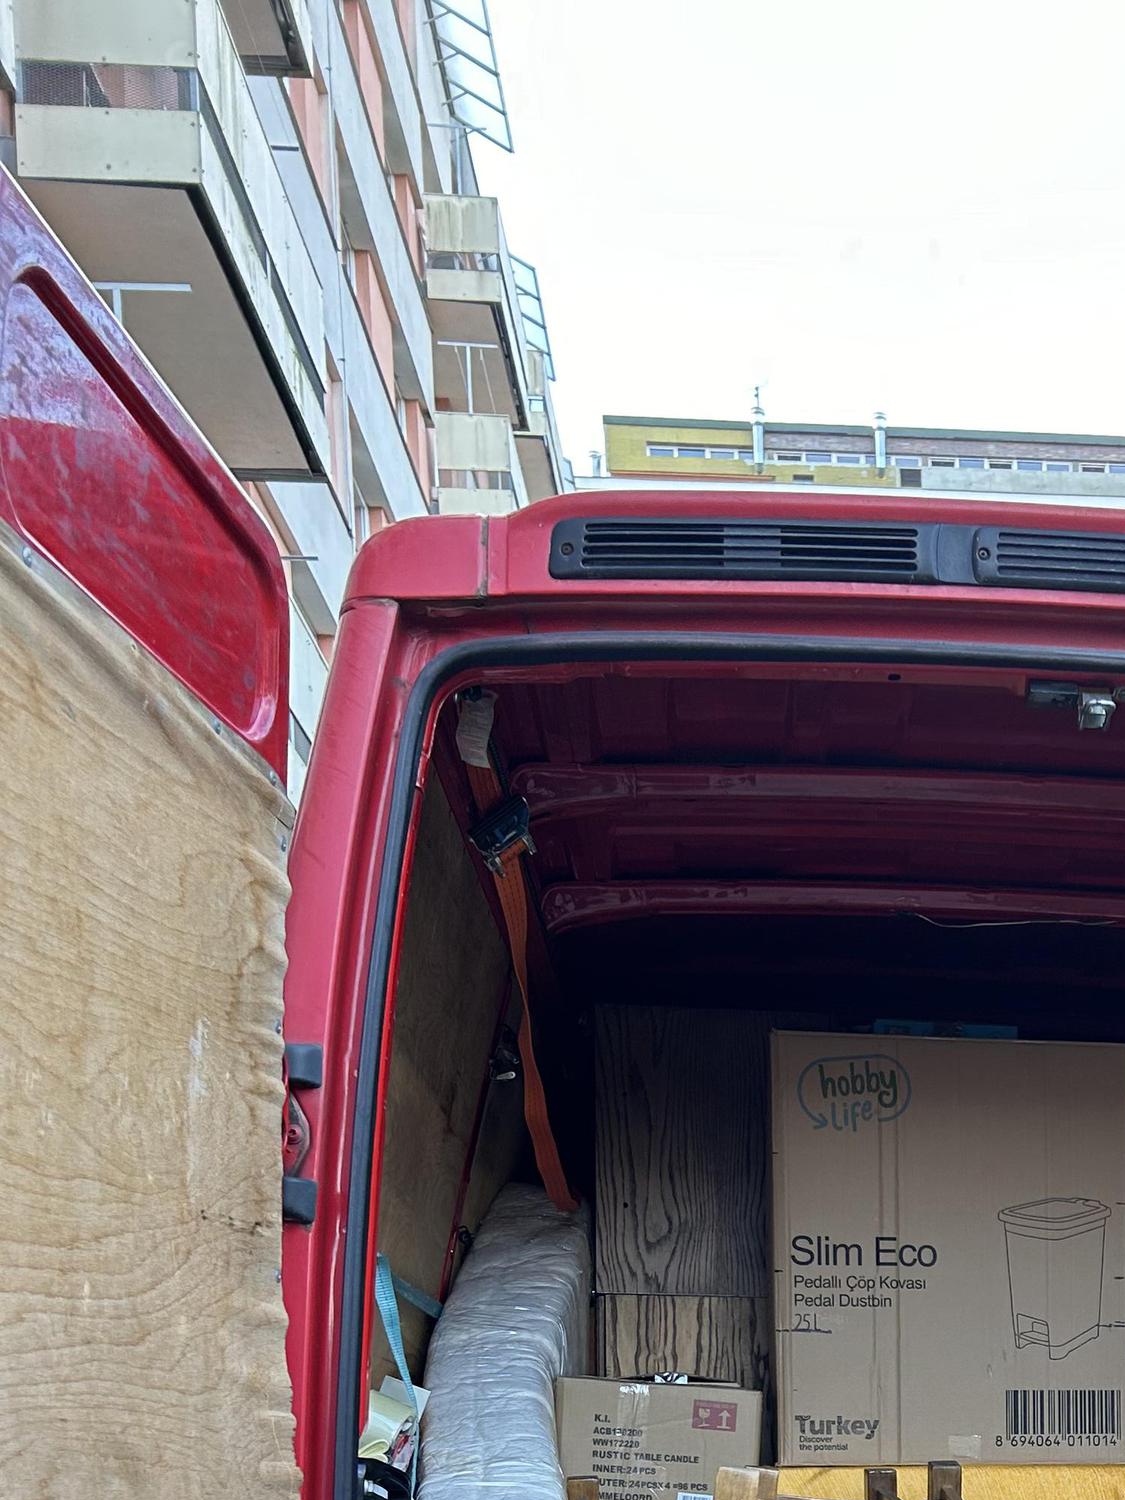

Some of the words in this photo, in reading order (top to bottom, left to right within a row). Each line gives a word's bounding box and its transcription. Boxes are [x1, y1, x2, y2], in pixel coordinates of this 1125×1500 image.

[818, 1060, 898, 1108] hobby
[790, 1235, 863, 1266] Slim
[875, 1236, 938, 1267] Eco
[794, 1275, 842, 1289] Pedallı
[846, 1275, 875, 1292] Çöp
[879, 1276, 927, 1290] Kovası
[794, 1294, 835, 1307] Pedal
[839, 1294, 892, 1308] Dustbin
[795, 1415, 880, 1440] Turkey
[799, 1435, 833, 1443] Discover
[995, 1435, 1003, 1447] 8
[1010, 1435, 1061, 1447] 694064
[1067, 1435, 1117, 1447] 011014
[813, 1444, 848, 1452] potential
[592, 1450, 631, 1460] RUSTIC
[634, 1453, 662, 1462] TABLE
[664, 1455, 700, 1464] CANDLE
[599, 1478, 627, 1488] UTER:
[690, 1483, 708, 1491] PCS
